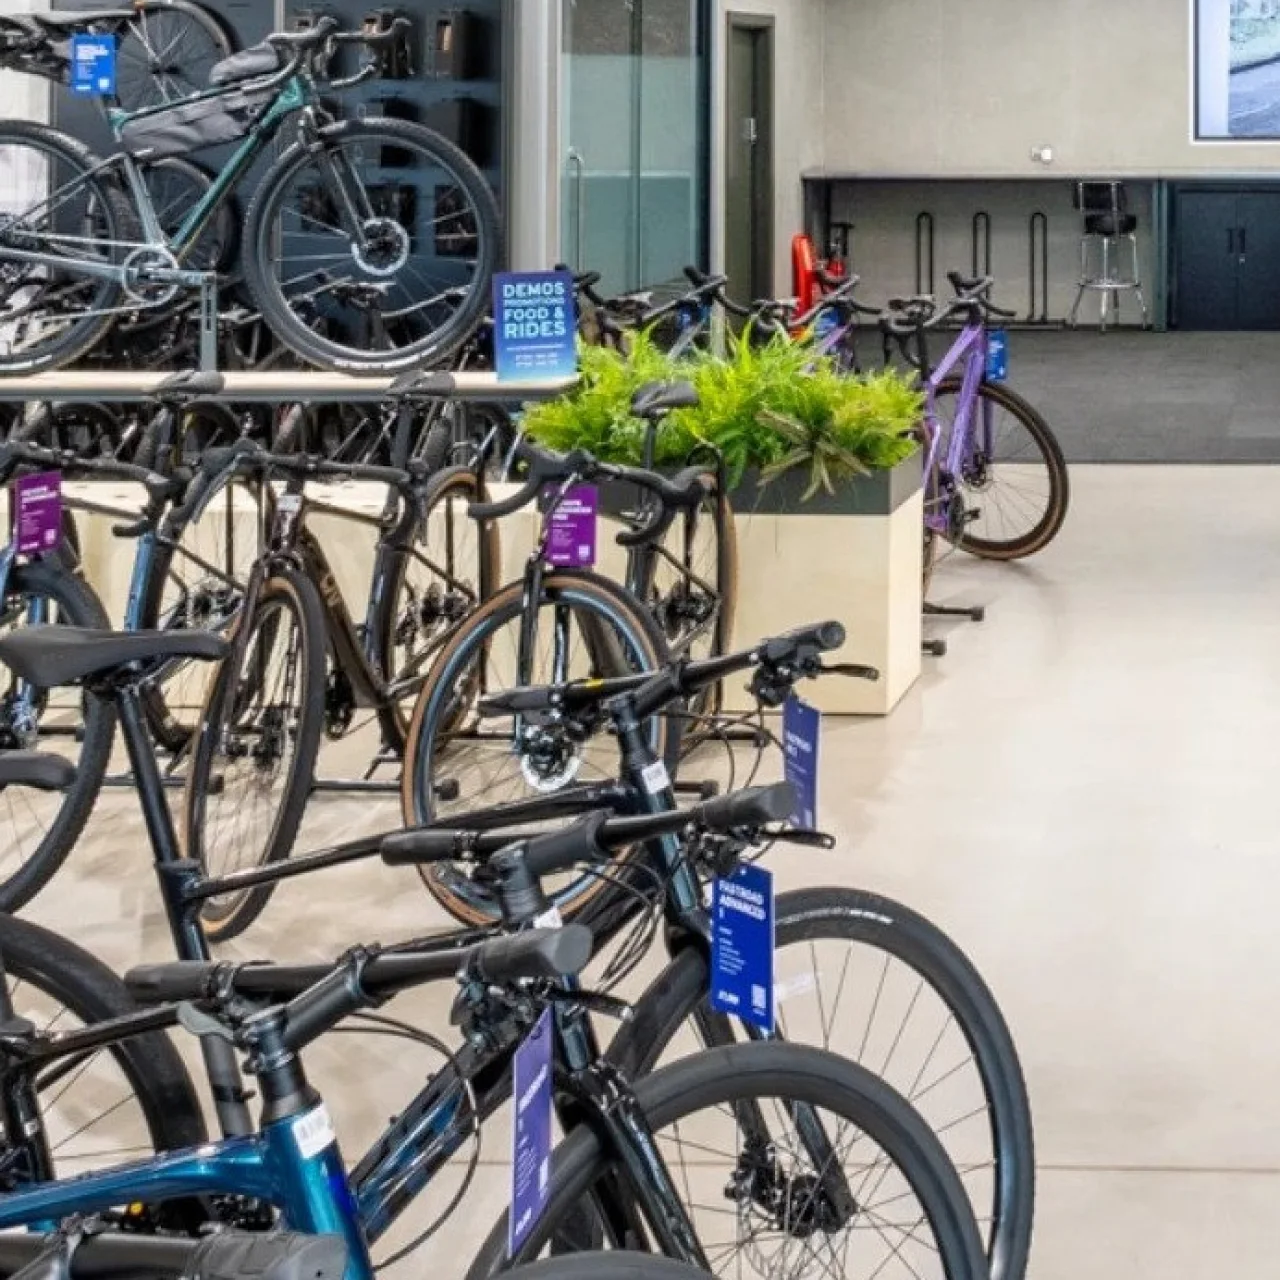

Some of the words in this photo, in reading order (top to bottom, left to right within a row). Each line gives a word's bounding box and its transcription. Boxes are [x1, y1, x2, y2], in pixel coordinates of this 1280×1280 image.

[502, 282, 566, 298] DEMOS
[504, 308, 550, 322] FOOD
[554, 306, 565, 319] &
[504, 321, 567, 339] RIDES
